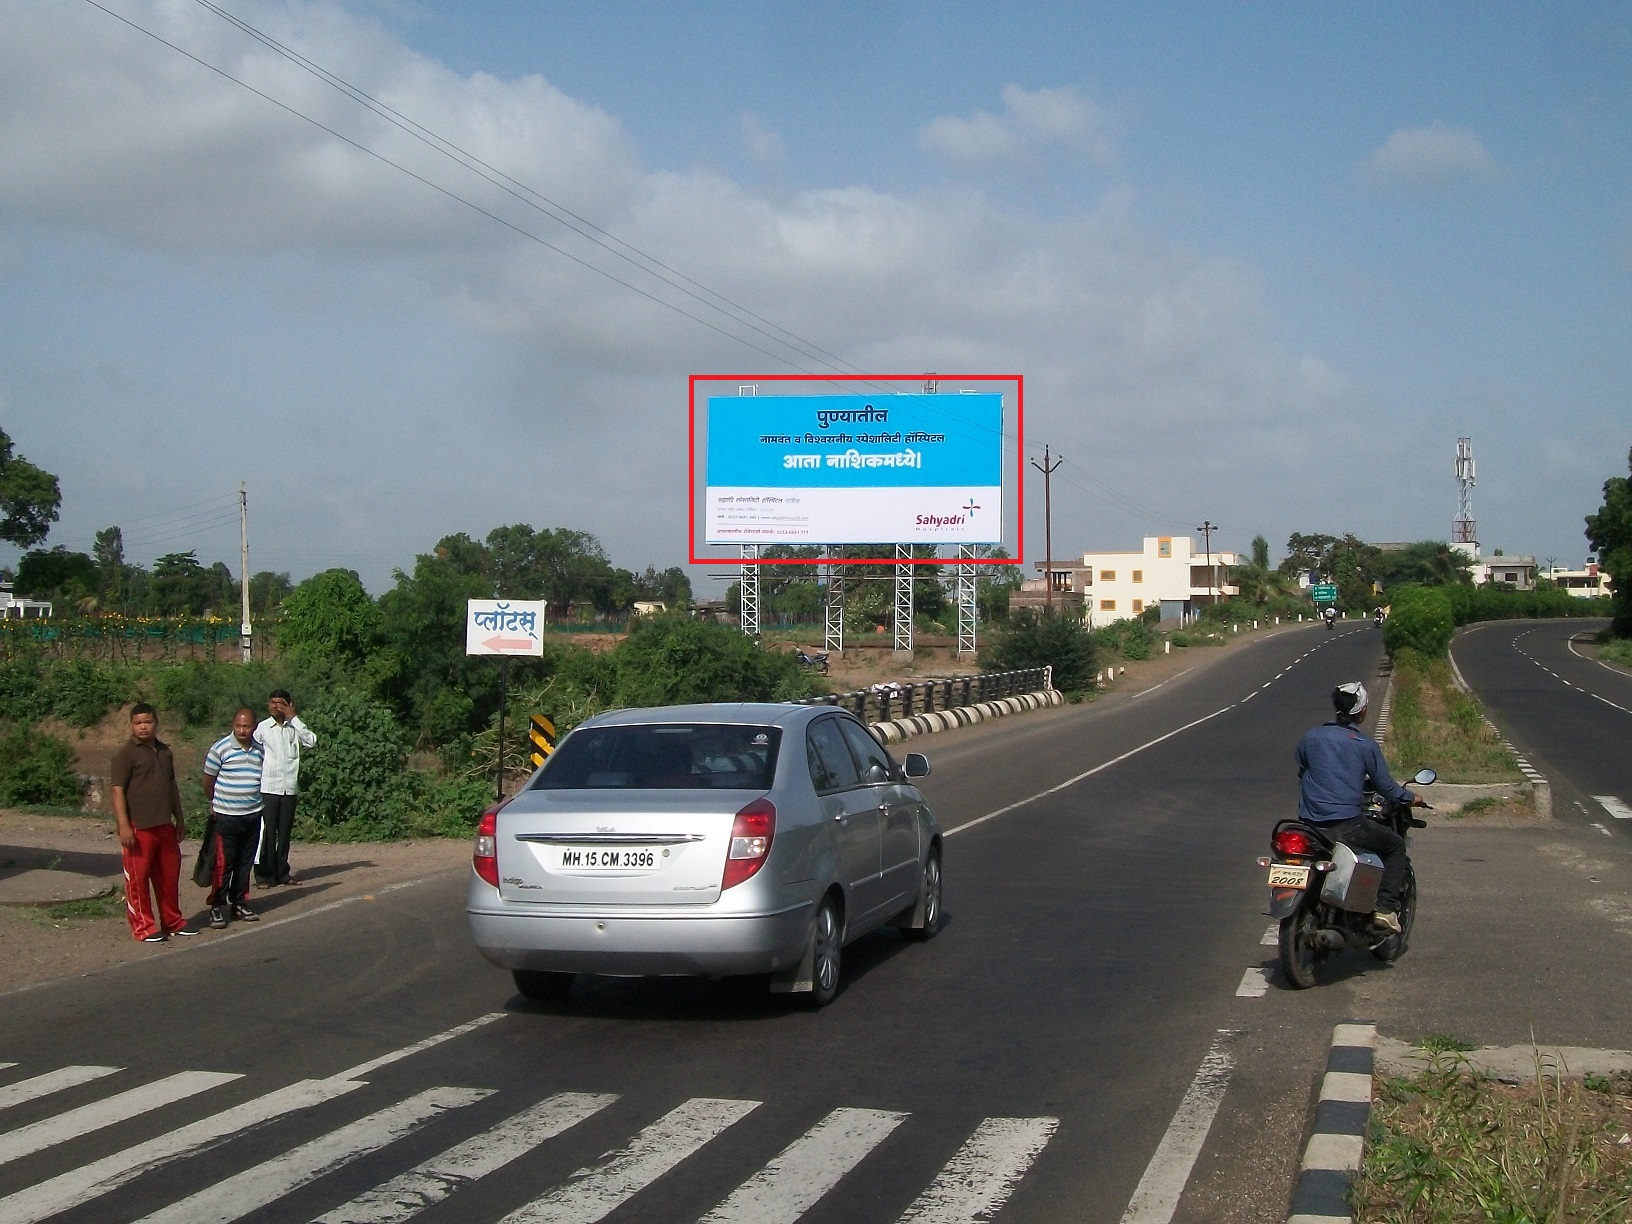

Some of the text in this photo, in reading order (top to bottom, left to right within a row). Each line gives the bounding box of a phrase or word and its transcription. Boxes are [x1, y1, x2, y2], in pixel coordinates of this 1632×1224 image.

[817, 405, 888, 429] पुण्यातील
[760, 431, 945, 444] नामवंत व विश्वसनीय स्पेशालिटी हॉस्पिटल
[783, 454, 821, 469] आता
[916, 514, 966, 527] Sahyadri
[474, 602, 538, 640] प्लॉटस्
[1271, 876, 1304, 885] 2008
